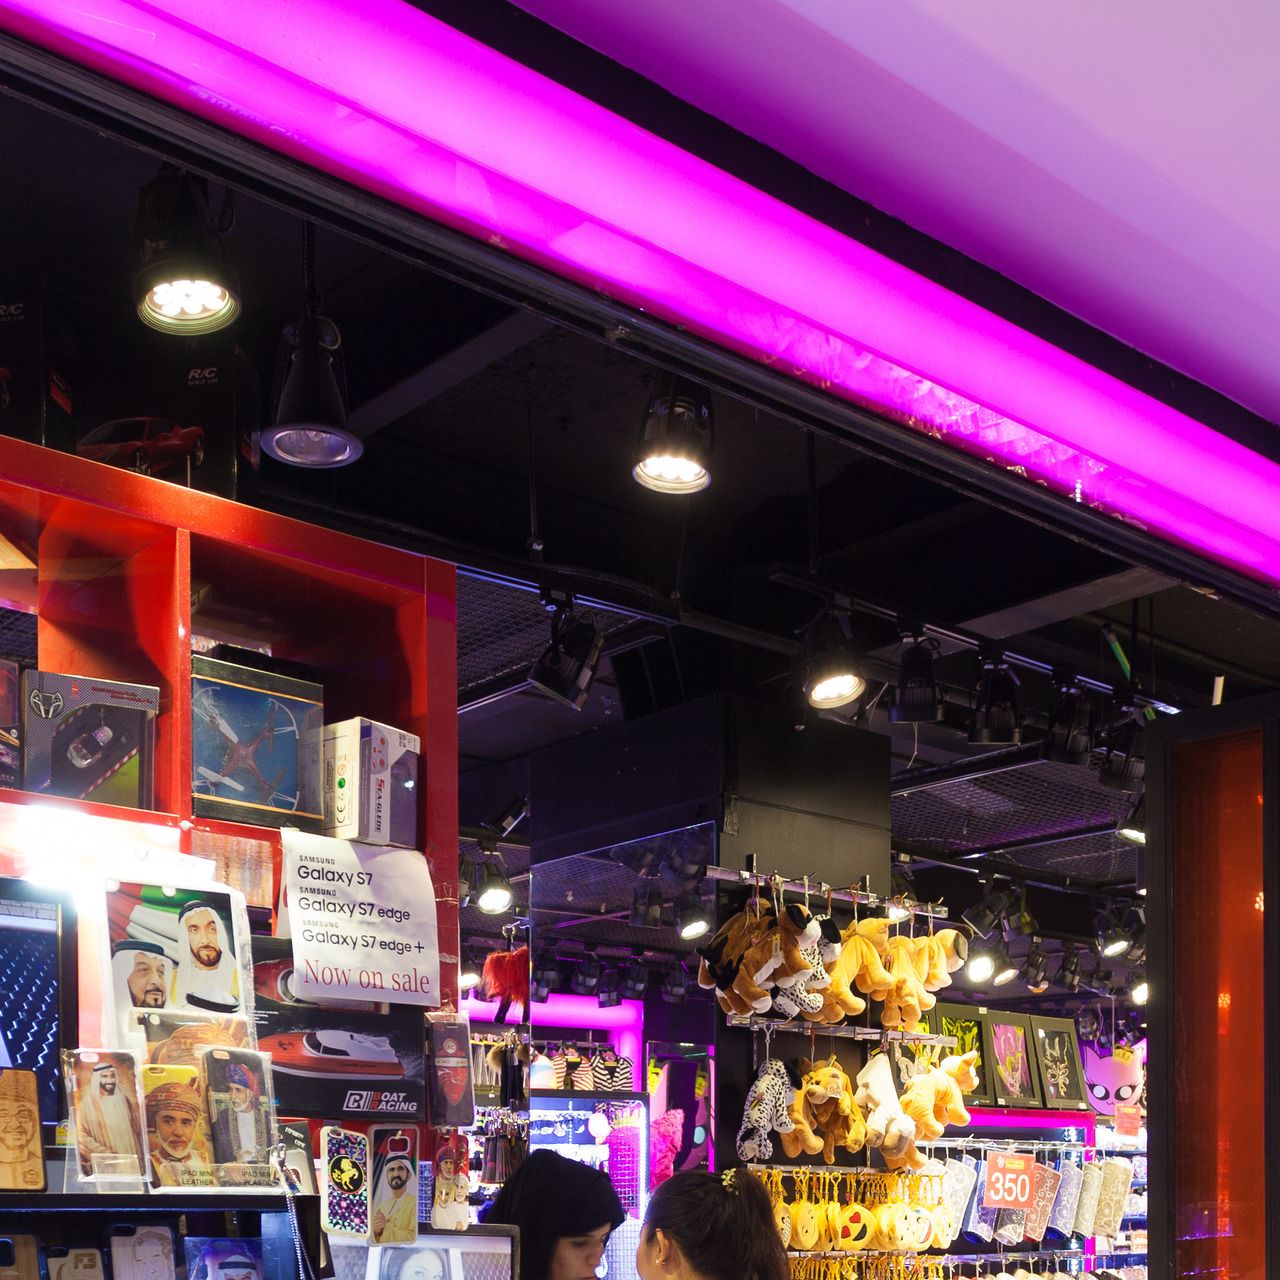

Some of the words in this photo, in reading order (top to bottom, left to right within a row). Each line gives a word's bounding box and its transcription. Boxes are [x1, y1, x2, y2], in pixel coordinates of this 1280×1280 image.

[299, 855, 335, 865] SAMSUNG
[297, 865, 353, 887] Galaxy
[357, 872, 373, 886] S7
[299, 886, 337, 897] SAMSUNG
[299, 897, 356, 918] Galaxy
[358, 902, 375, 916] S7
[377, 907, 411, 923] edge
[302, 929, 358, 951] Galaxy
[361, 935, 377, 949] S7
[304, 959, 351, 986] Now
[359, 968, 385, 990] on
[391, 967, 430, 994] sale
[370, 1101, 418, 1111] RACING
[373, 1091, 407, 1101] BOAT
[990, 1172, 1030, 1202] 350
